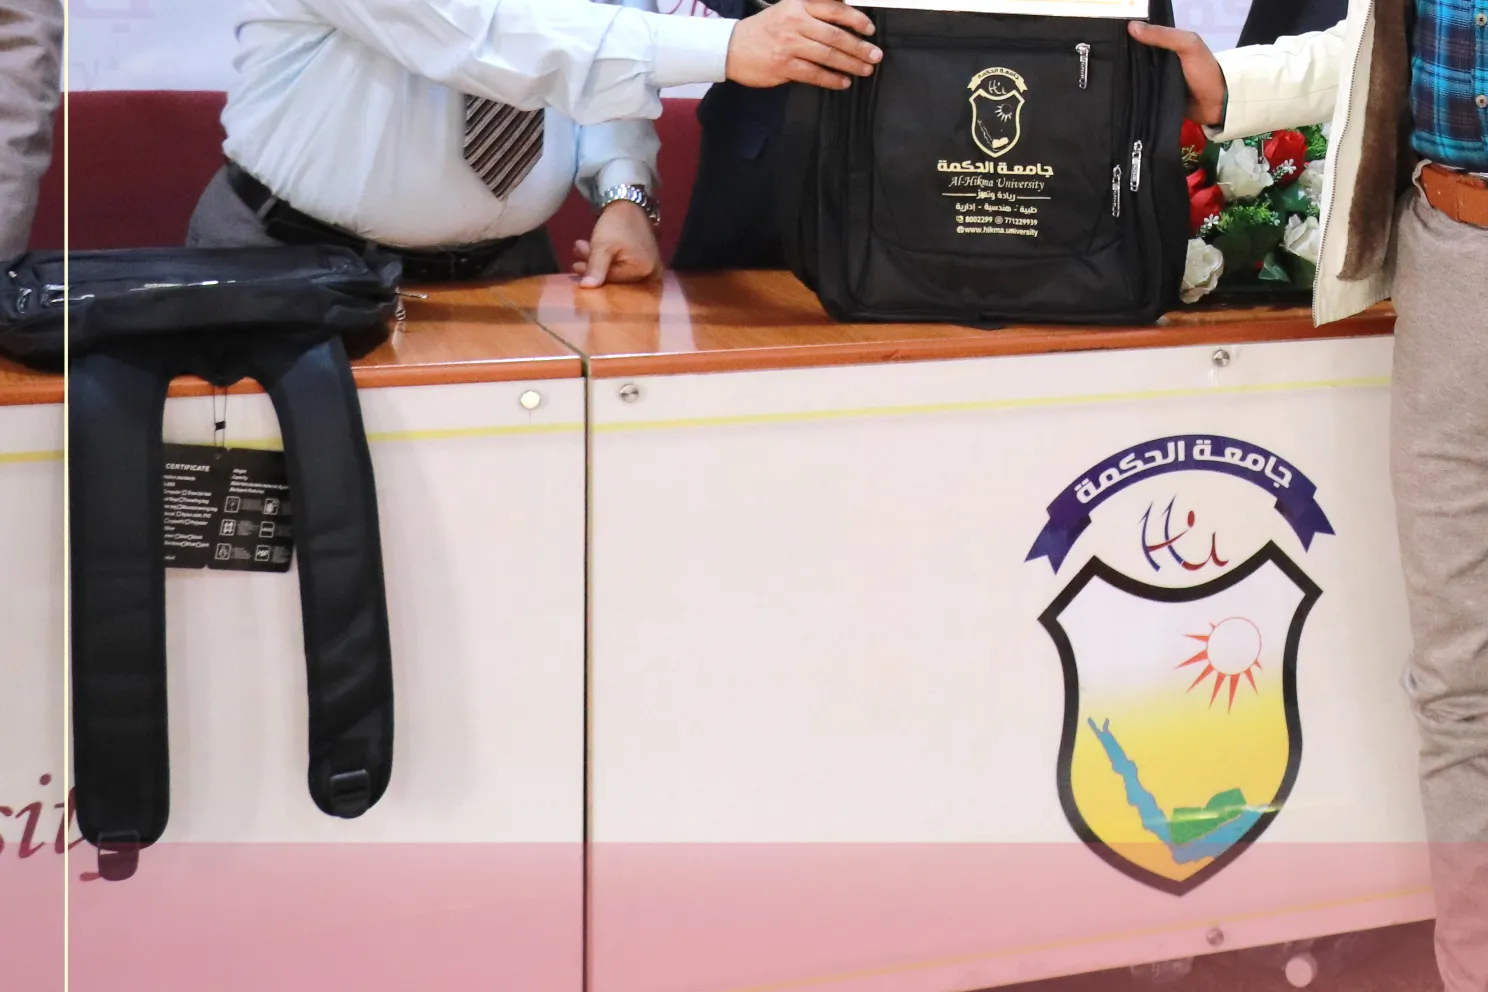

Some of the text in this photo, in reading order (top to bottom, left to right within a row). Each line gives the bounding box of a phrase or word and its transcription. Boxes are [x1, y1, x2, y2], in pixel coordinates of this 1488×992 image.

[936, 159, 1055, 178] جامعة الحكمة
[948, 174, 1045, 192] Al-Hikma University
[975, 189, 1016, 202] ريادة وتميز
[983, 202, 1012, 213] هندسية
[1019, 205, 1038, 216] طبية
[165, 462, 211, 473] CERTIFICATE
[1075, 438, 1293, 505] جامعة الحكمة
